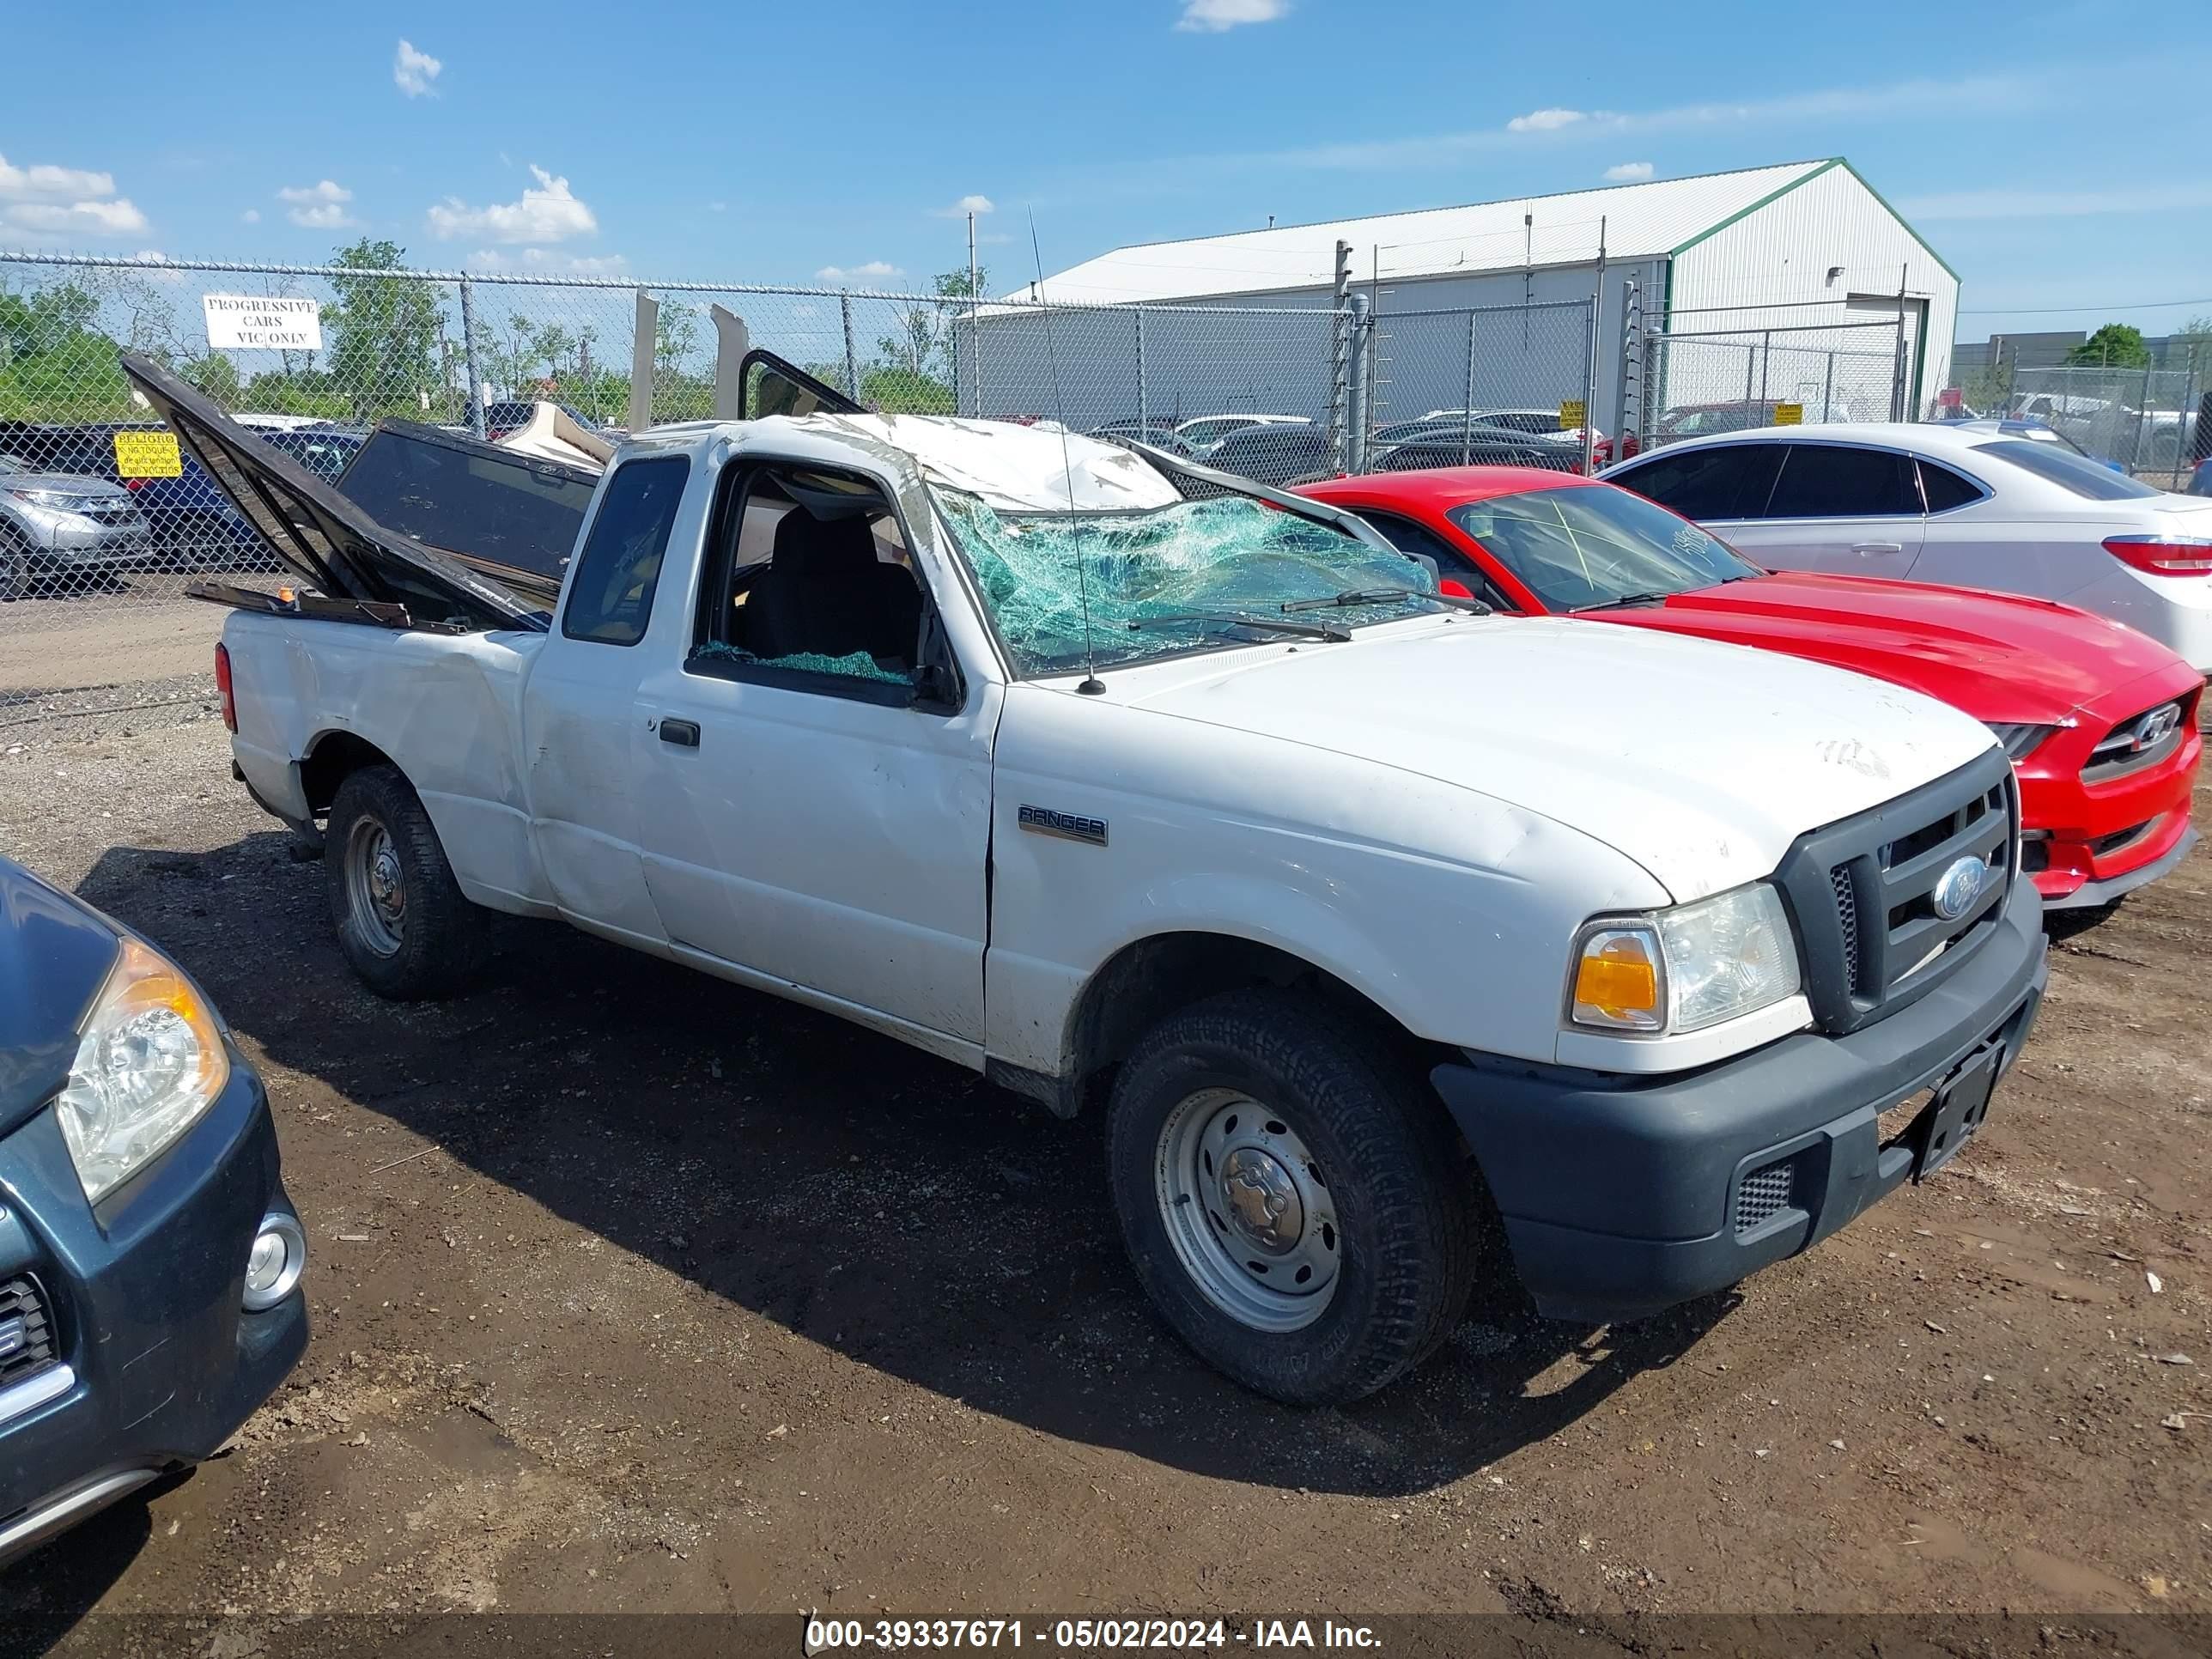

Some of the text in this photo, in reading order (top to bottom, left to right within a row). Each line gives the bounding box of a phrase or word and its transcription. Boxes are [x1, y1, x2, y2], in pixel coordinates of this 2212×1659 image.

[208, 298, 315, 313] PROGRESSIVE
[242, 315, 283, 327] CARS
[237, 331, 307, 344] VIC ONLY
[118, 434, 174, 444] PELIGRO
[1018, 806, 1107, 839] RANGER
